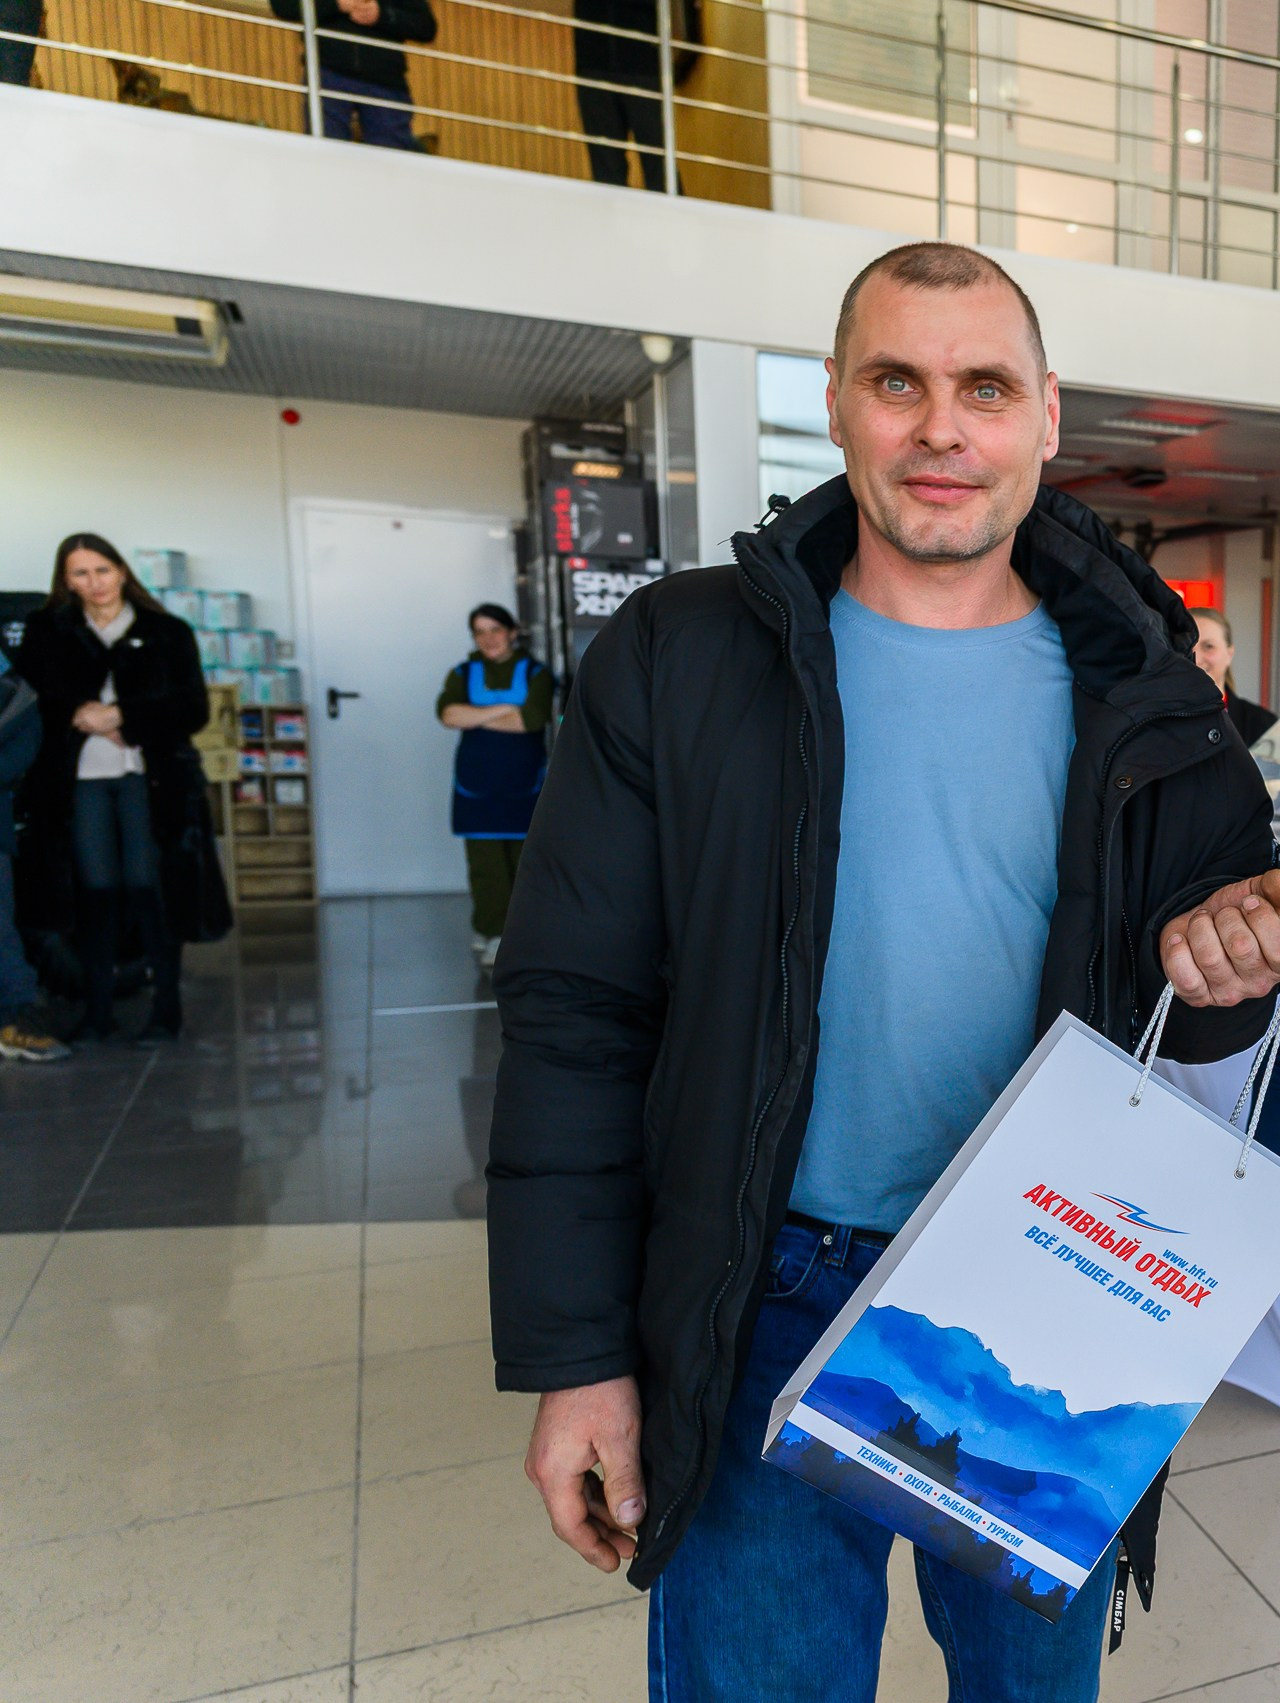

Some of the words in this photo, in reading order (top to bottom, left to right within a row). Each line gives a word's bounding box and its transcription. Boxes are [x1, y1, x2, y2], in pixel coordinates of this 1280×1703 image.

[1022, 1183, 1142, 1262] АКТИВНЫЙ
[1134, 1252, 1212, 1308] ОТДЫХ
[1024, 1225, 1059, 1250] ВСЁ
[1052, 1244, 1114, 1286] ЛУЧШЕЕ
[1107, 1279, 1144, 1305] ДЛЯ
[1139, 1298, 1171, 1323] ВАС
[1162, 1248, 1219, 1289] www.hft.ru
[856, 1445, 898, 1475] ТЕХНИКА
[903, 1473, 934, 1496] ОХОТА
[936, 1493, 983, 1525] РЫБАЛКА
[985, 1521, 1024, 1549] ТУРИЗМ
